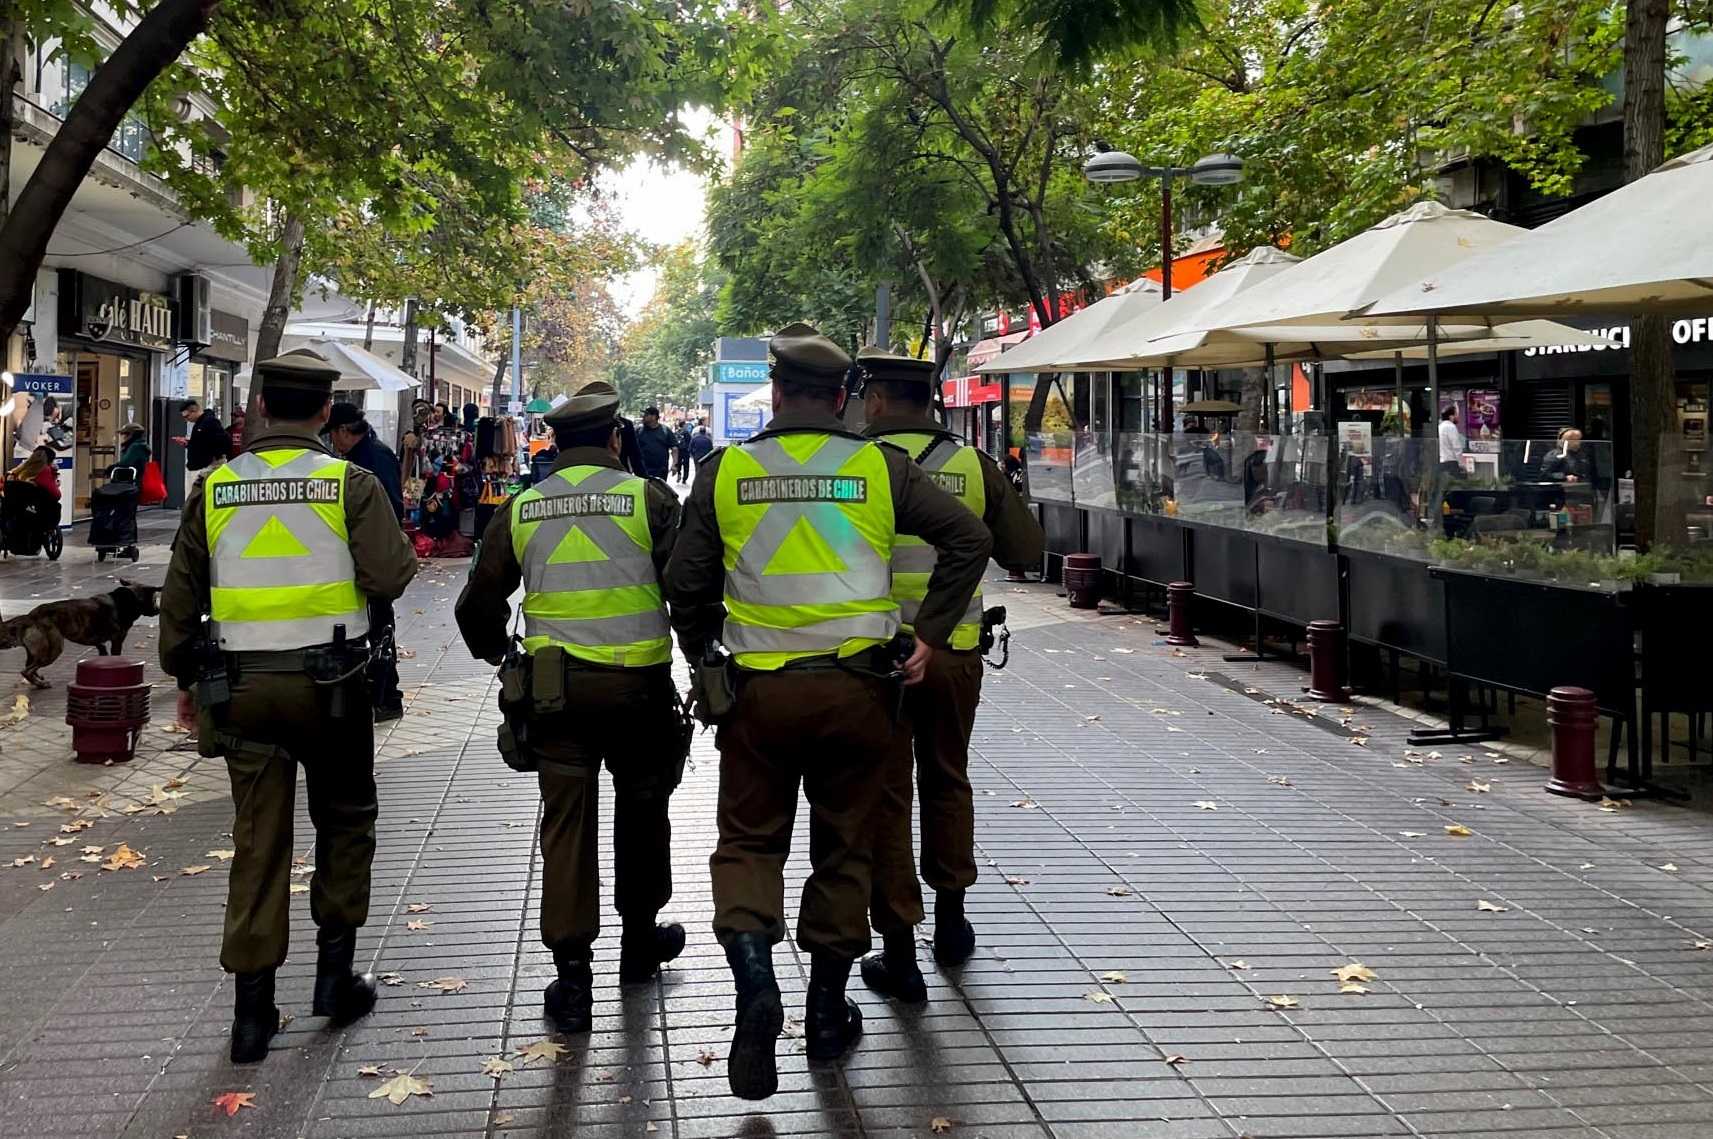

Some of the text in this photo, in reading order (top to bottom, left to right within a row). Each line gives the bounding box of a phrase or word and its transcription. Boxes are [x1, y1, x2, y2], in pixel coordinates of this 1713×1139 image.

[129, 299, 172, 339] HAITI
[727, 366, 766, 378] Baños
[24, 381, 61, 391] VOKER
[215, 480, 338, 505] CARABINEROS DE CHILE
[740, 479, 865, 501] CARABINEROS DE CHILE
[521, 494, 633, 520] CARABINEROS DE CHILE
